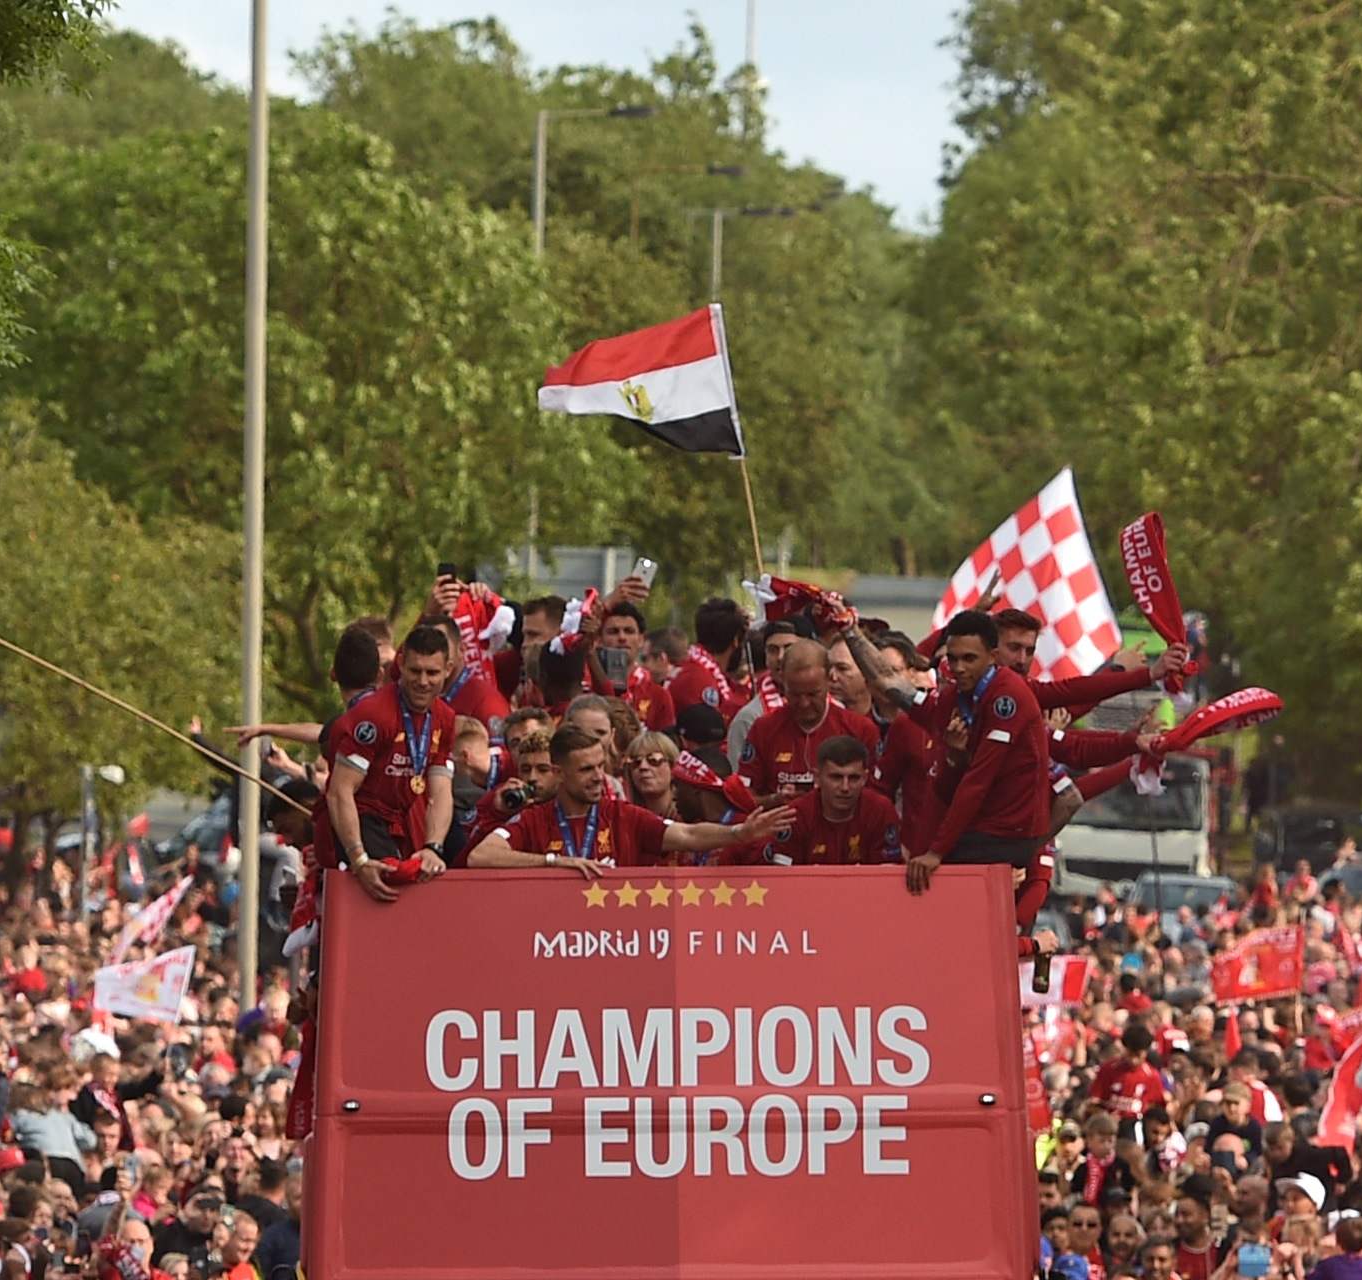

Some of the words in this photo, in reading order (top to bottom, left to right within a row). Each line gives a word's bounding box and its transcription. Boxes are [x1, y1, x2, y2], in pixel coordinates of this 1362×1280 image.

[649, 928, 670, 959] 19
[688, 930, 817, 956] FINAL
[425, 1005, 930, 1091] CHAMPIONS
[447, 1097, 551, 1180] OF
[584, 1094, 910, 1178] EUROPE
